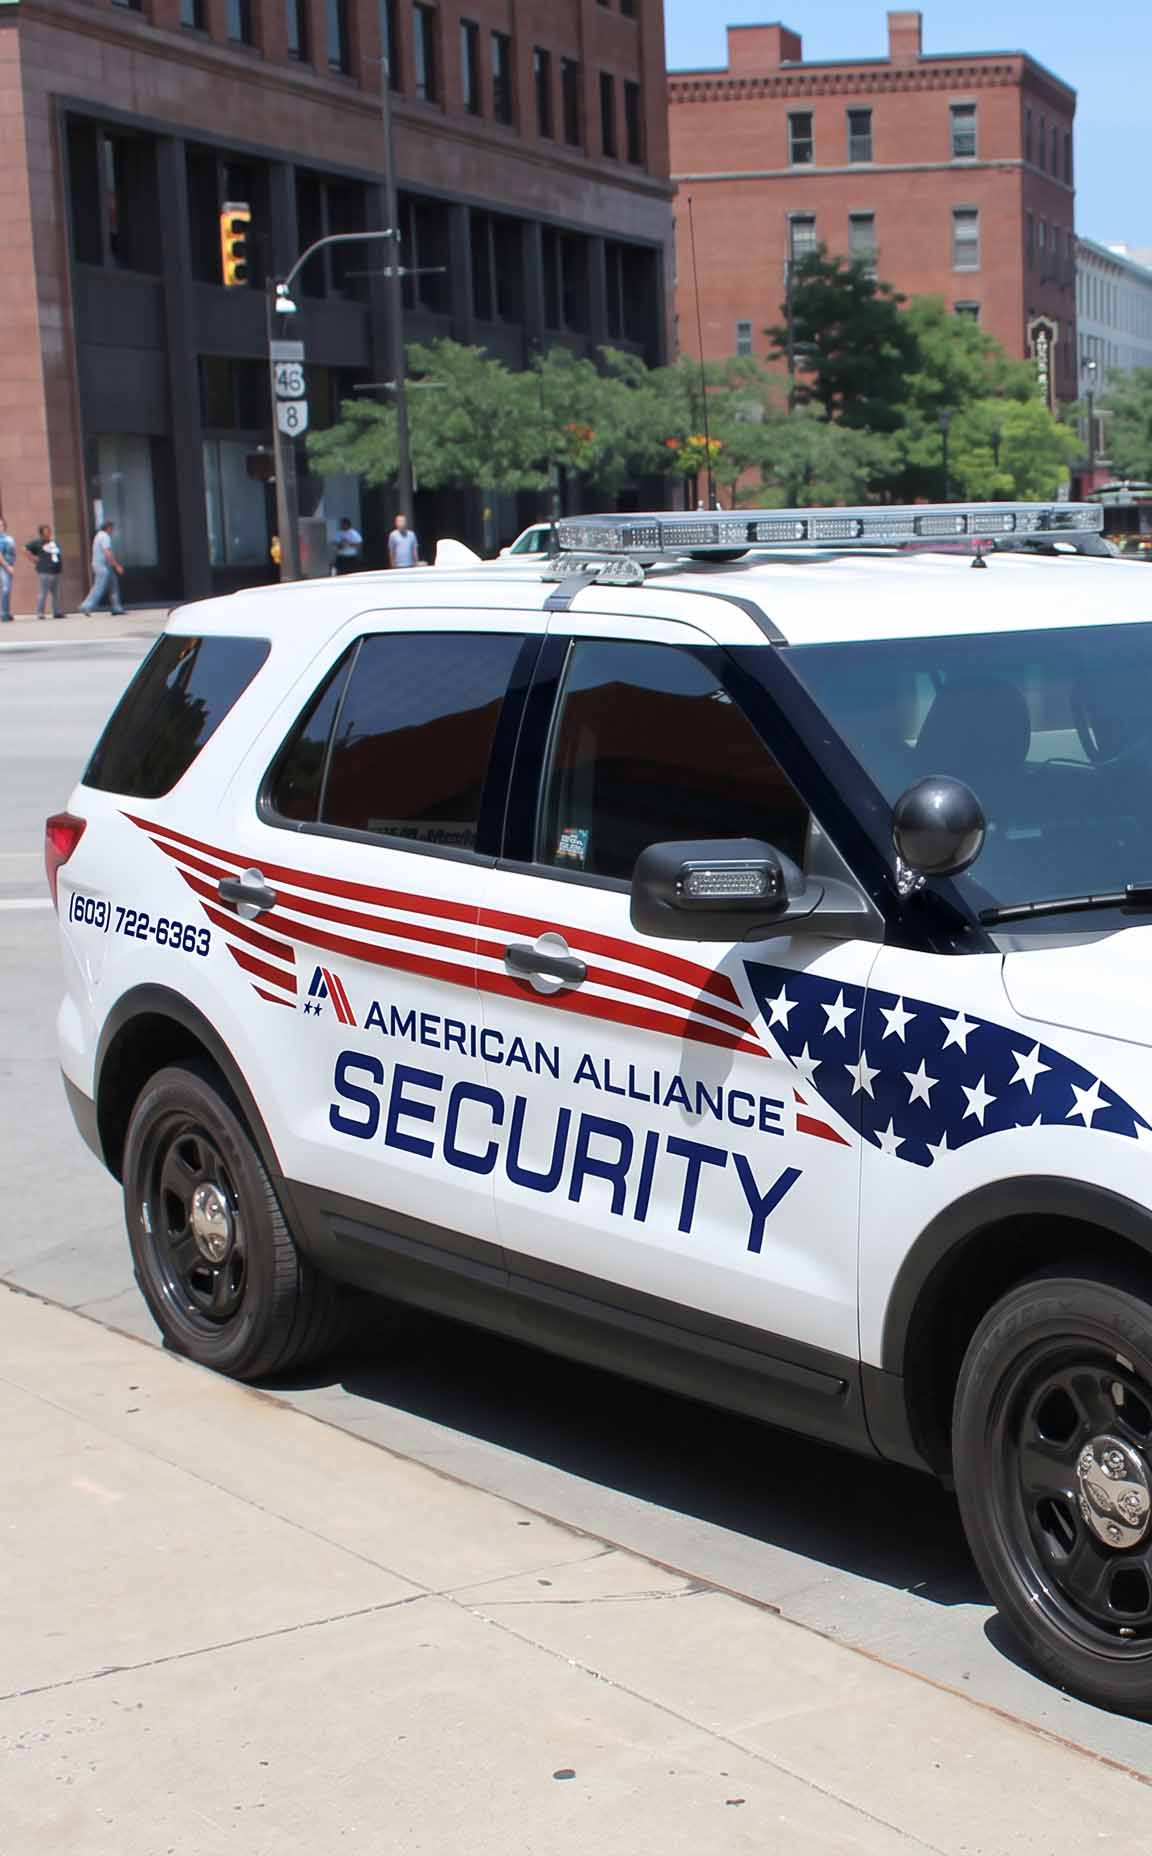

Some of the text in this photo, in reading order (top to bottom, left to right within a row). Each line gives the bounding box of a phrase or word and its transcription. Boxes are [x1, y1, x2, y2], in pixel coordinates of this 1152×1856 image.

[279, 367, 302, 392] 46
[287, 405, 299, 428] 8
[69, 892, 212, 957] (603) 722-6363
[364, 1000, 785, 1136] AMERICAN ALLIANCE
[328, 1049, 804, 1254] SECURITY
